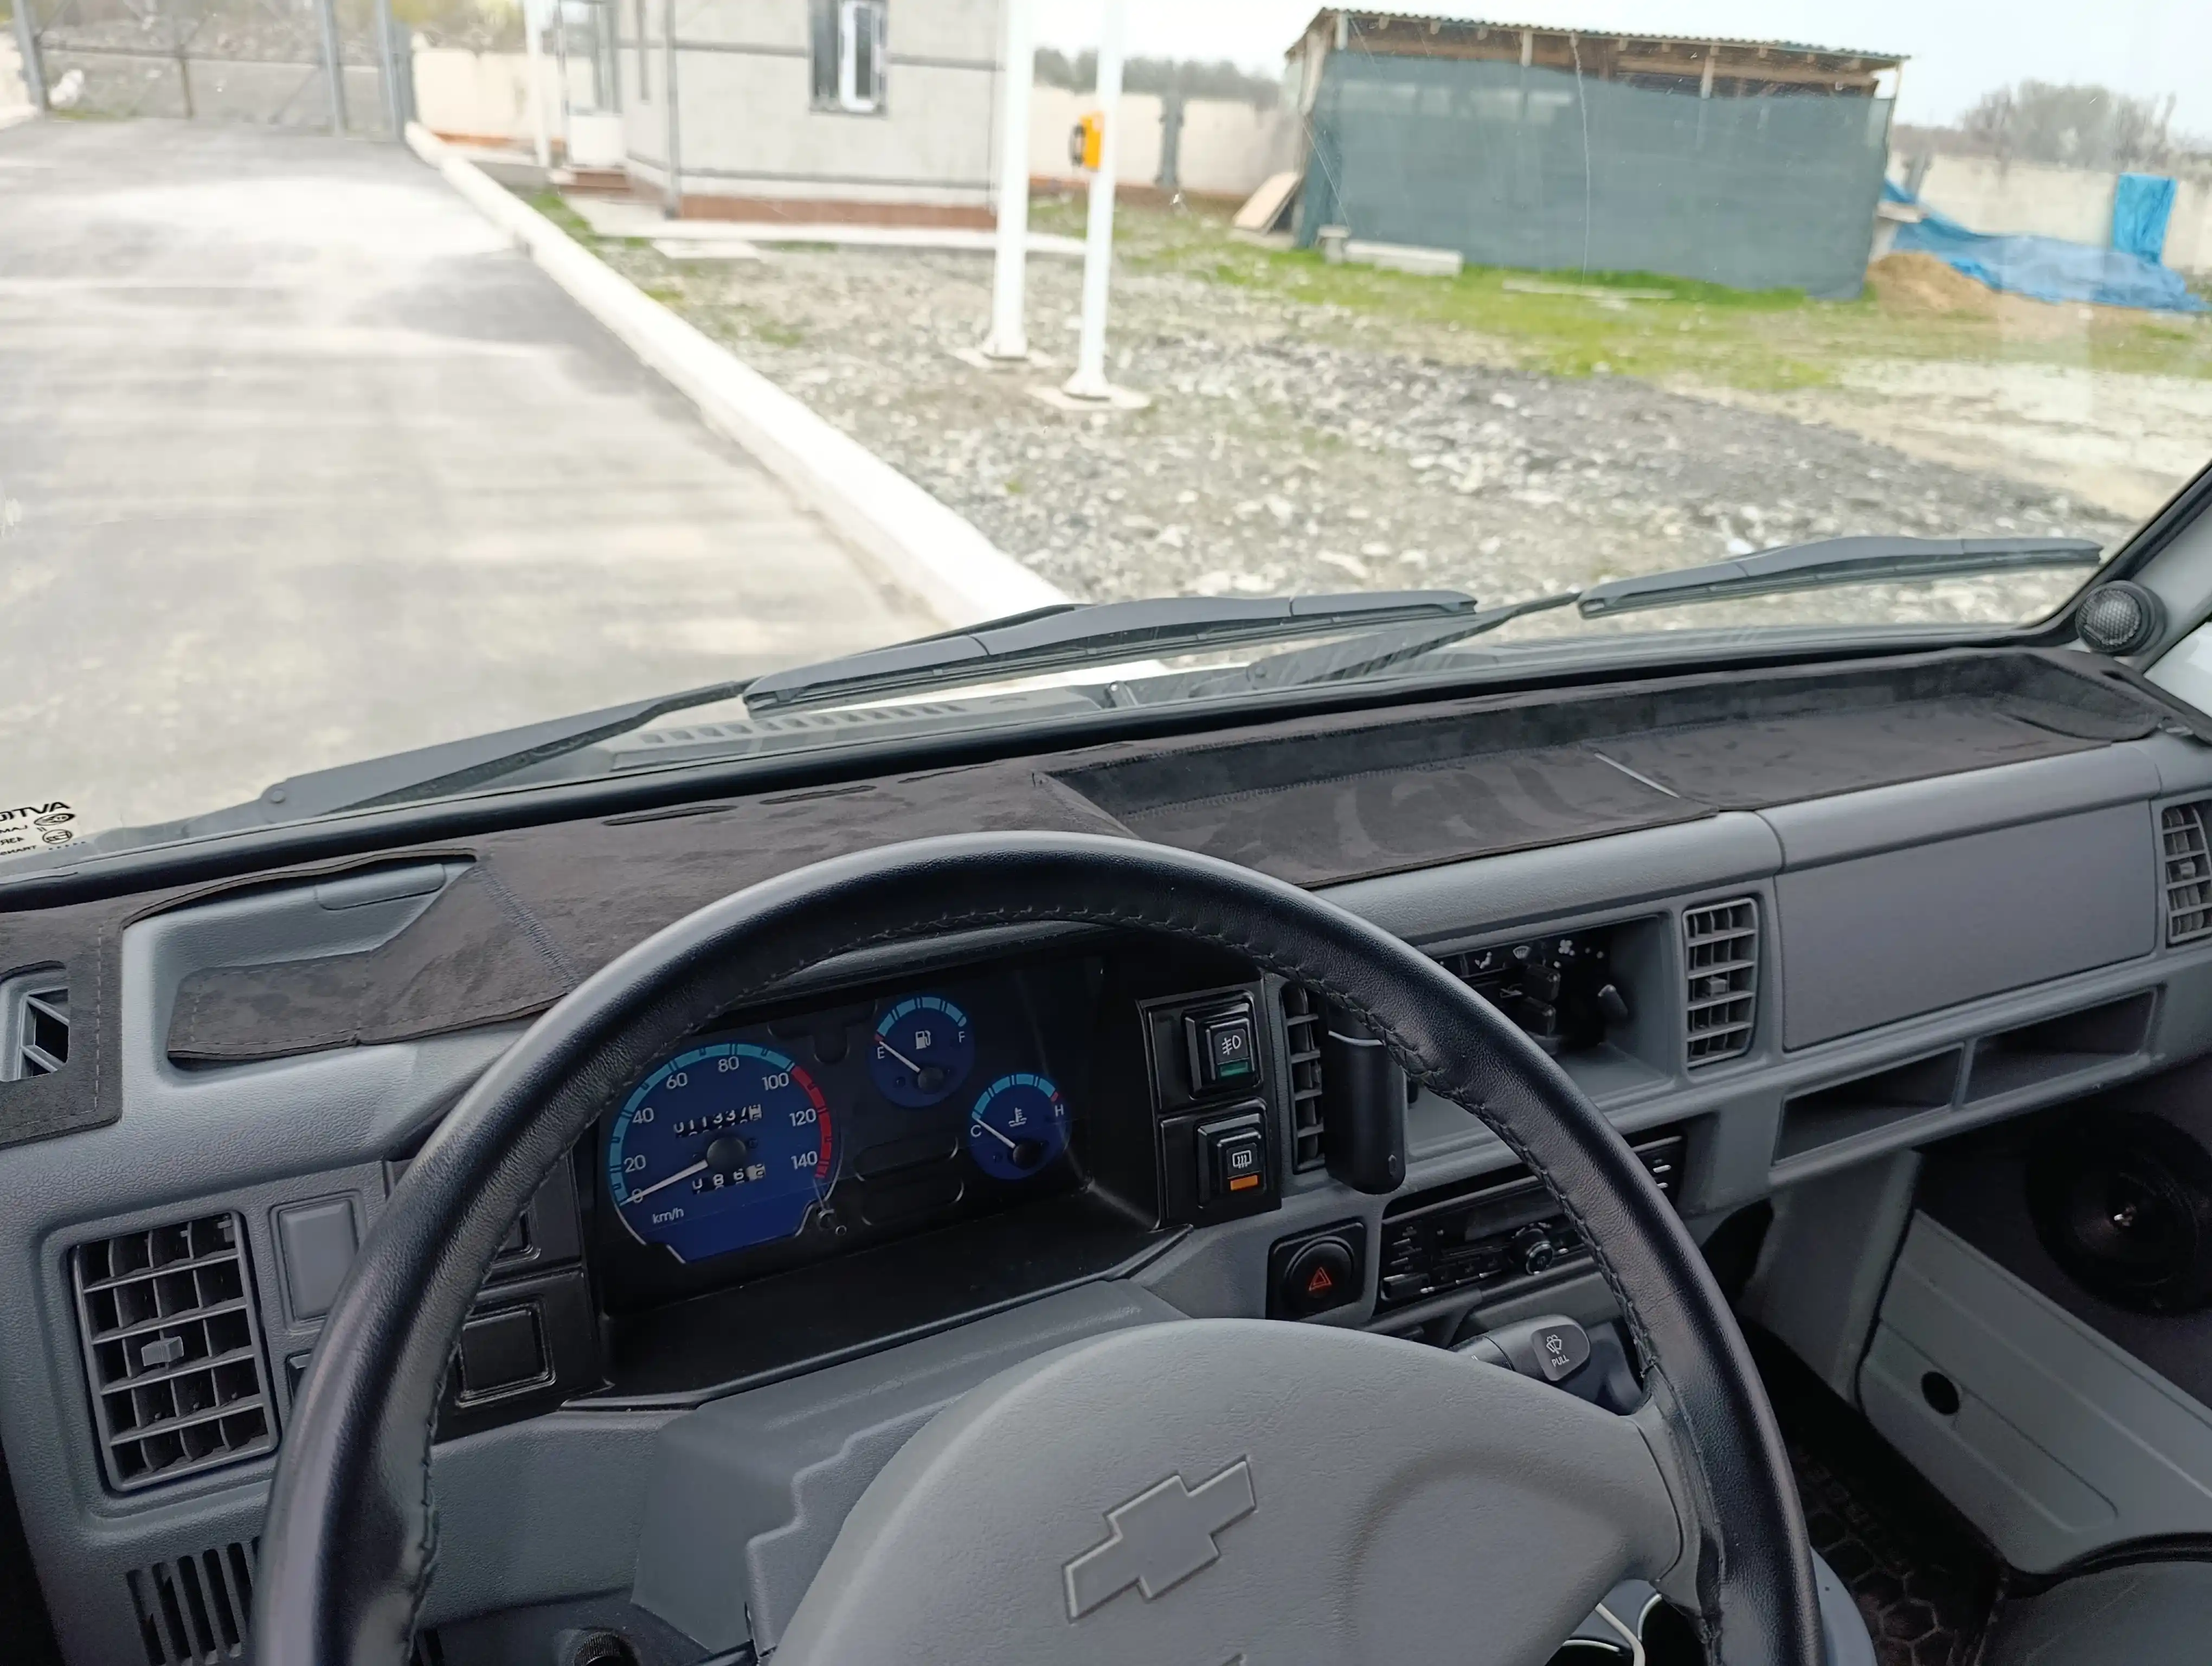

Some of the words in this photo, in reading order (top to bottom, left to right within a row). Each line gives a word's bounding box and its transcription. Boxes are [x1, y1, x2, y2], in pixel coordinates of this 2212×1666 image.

[958, 1030, 966, 1043] F
[877, 1047, 885, 1059] E
[717, 1056, 740, 1073] 80
[665, 1072, 688, 1090] 60
[761, 1072, 789, 1091] 100
[632, 1107, 654, 1124] 40
[789, 1108, 816, 1127] 120
[1054, 1104, 1064, 1117] H
[970, 1124, 982, 1137] C
[623, 1154, 647, 1173] 20
[790, 1150, 818, 1170] 140
[652, 1207, 685, 1224] km/h
[1551, 1354, 1570, 1367] PULL
